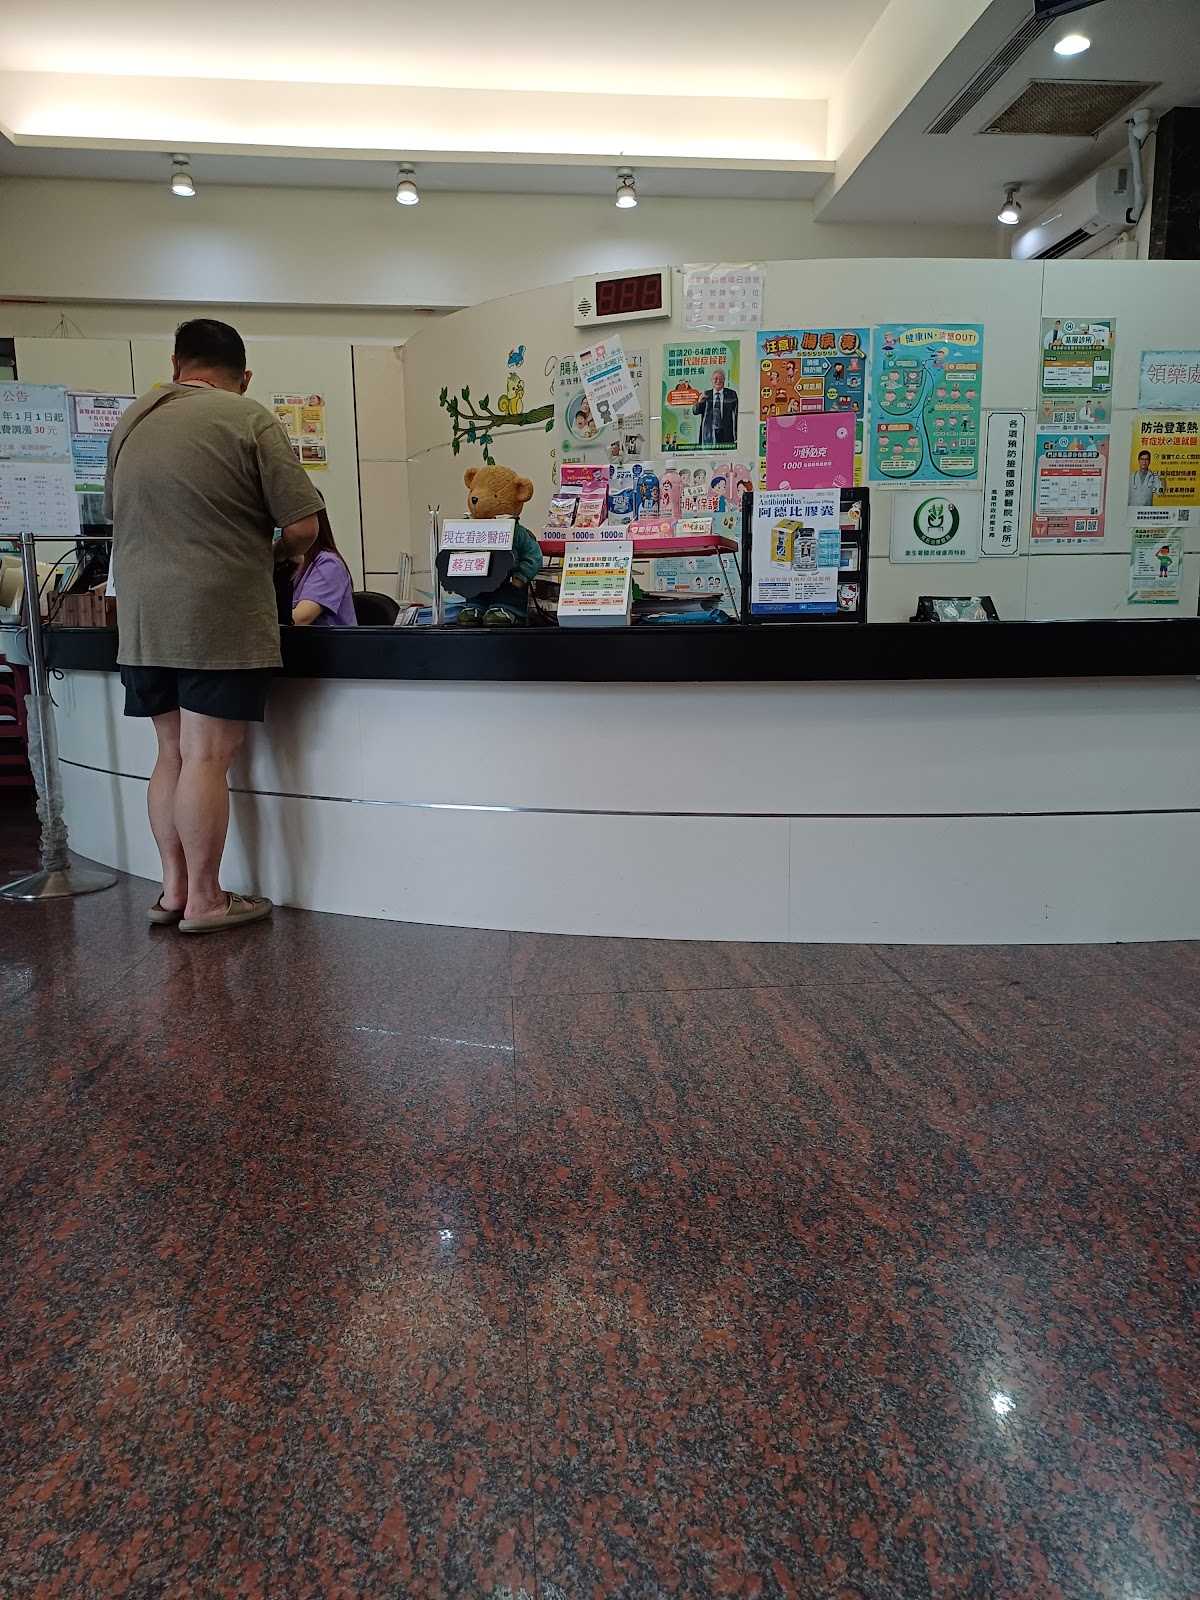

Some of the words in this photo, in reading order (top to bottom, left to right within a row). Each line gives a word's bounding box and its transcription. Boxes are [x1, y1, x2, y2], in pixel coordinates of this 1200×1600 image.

[752, 289, 760, 297] 位
[766, 338, 798, 353] 注意!!
[801, 332, 857, 351] 腸病毒
[1065, 336, 1092, 344] 基層診所
[1146, 363, 1200, 385] 領藥處
[610, 384, 623, 395] 100
[3, 390, 28, 402] 公告
[3, 411, 12, 421] 年
[15, 412, 20, 420] 1
[24, 411, 32, 421] 月
[44, 412, 64, 422] 日起
[0, 425, 32, 434] 費調漲
[48, 425, 57, 435] 元
[1141, 421, 1198, 434] 防治登革熱
[1141, 437, 1166, 446] 有症狀
[1172, 437, 1198, 446] 速就醫
[783, 461, 802, 470] 1000
[758, 497, 802, 506] Antibiophilus
[758, 505, 835, 518] 阿德比膠囊
[443, 530, 511, 545] 現在看診醫師
[451, 556, 486, 572] 蔡宜馨
